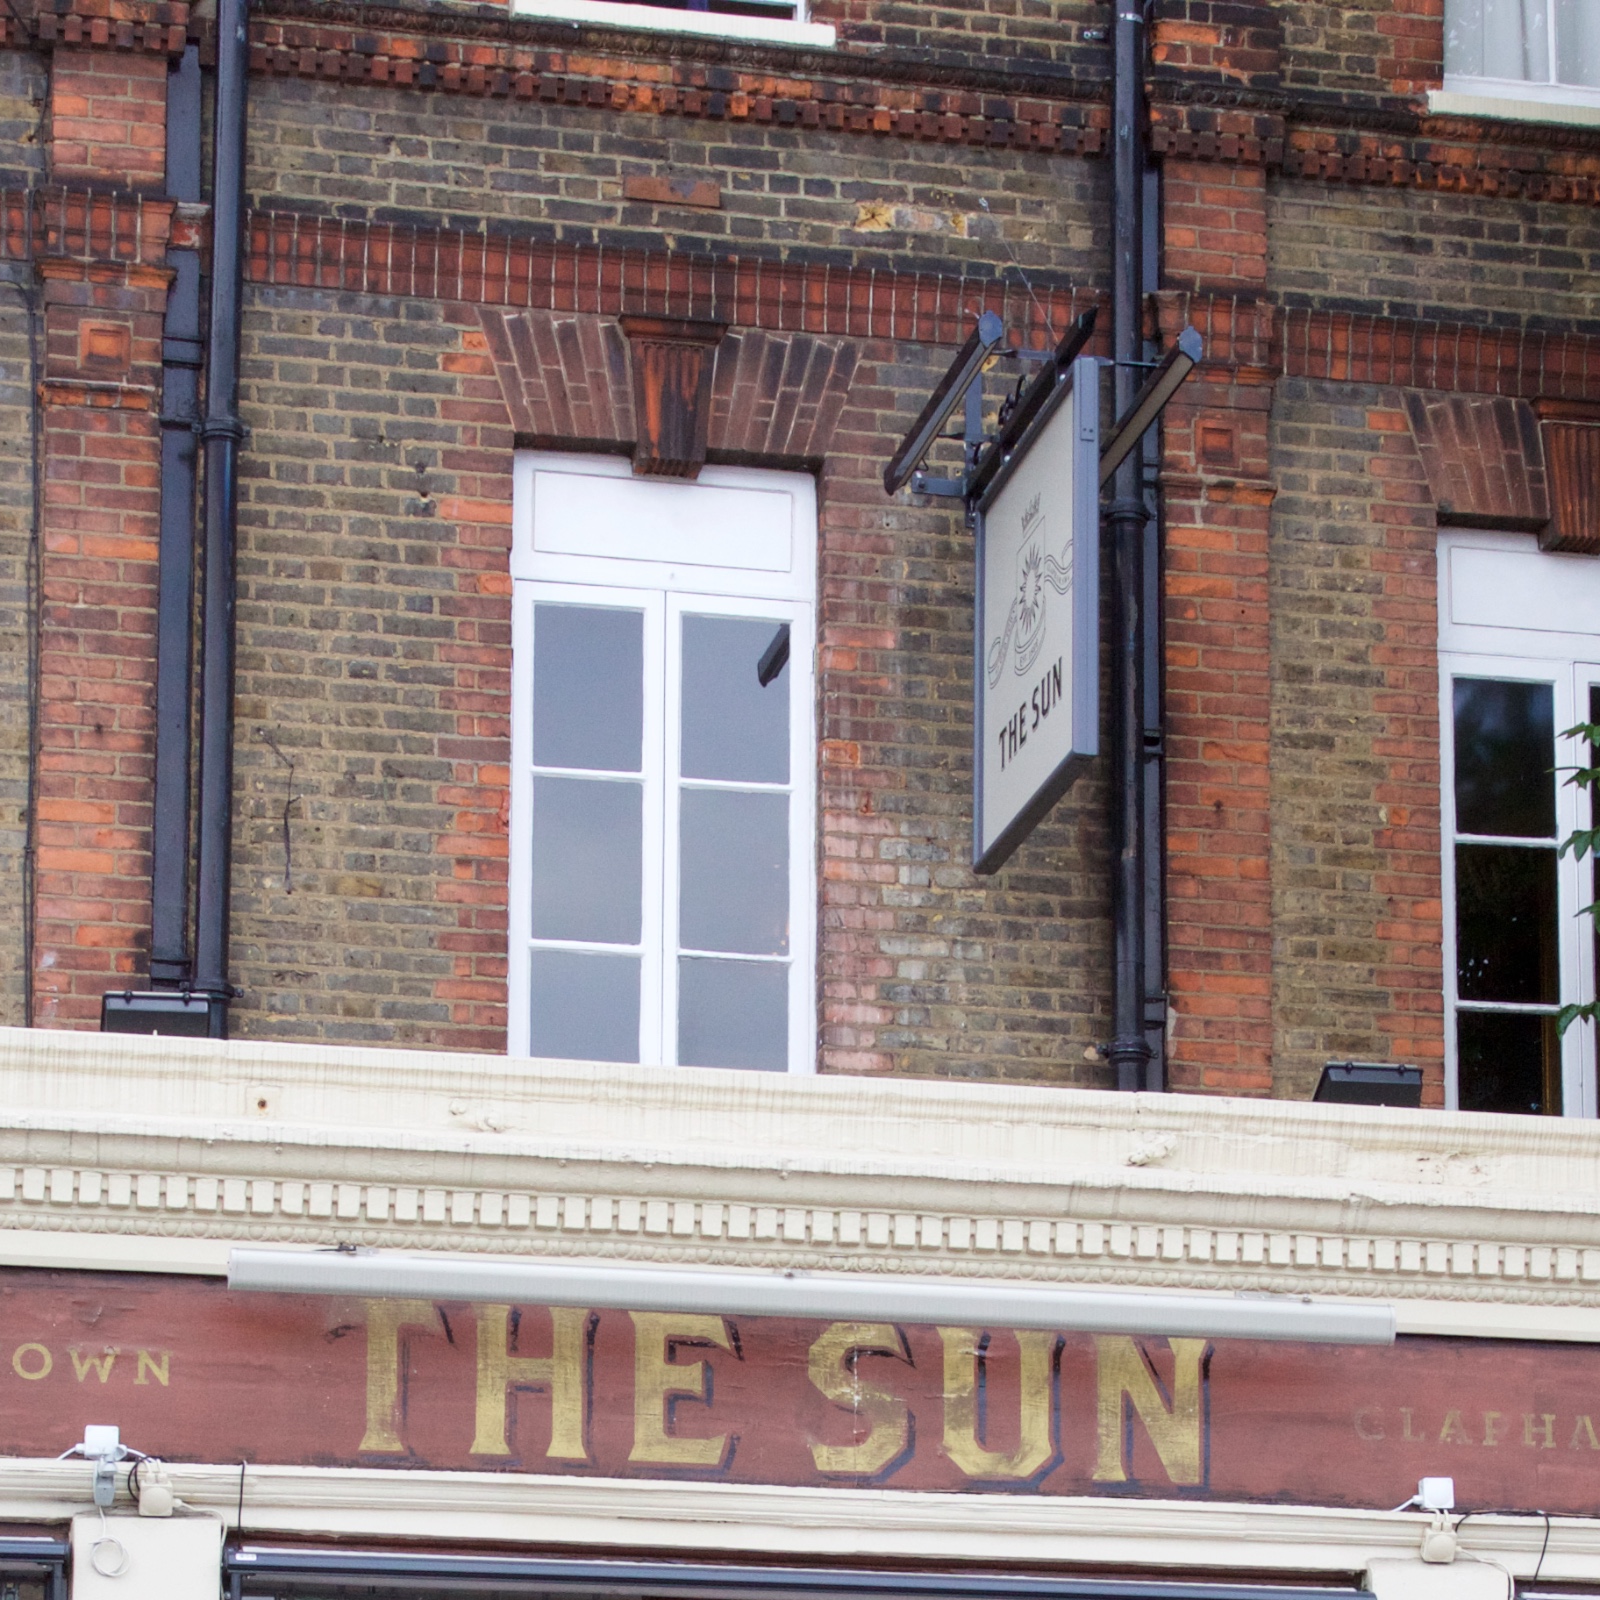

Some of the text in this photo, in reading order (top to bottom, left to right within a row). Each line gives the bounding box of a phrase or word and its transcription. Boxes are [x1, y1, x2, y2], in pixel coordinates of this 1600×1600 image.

[998, 702, 1028, 772] THE
[1031, 656, 1063, 731] SUN
[330, 1296, 1213, 1490] THE SUN
